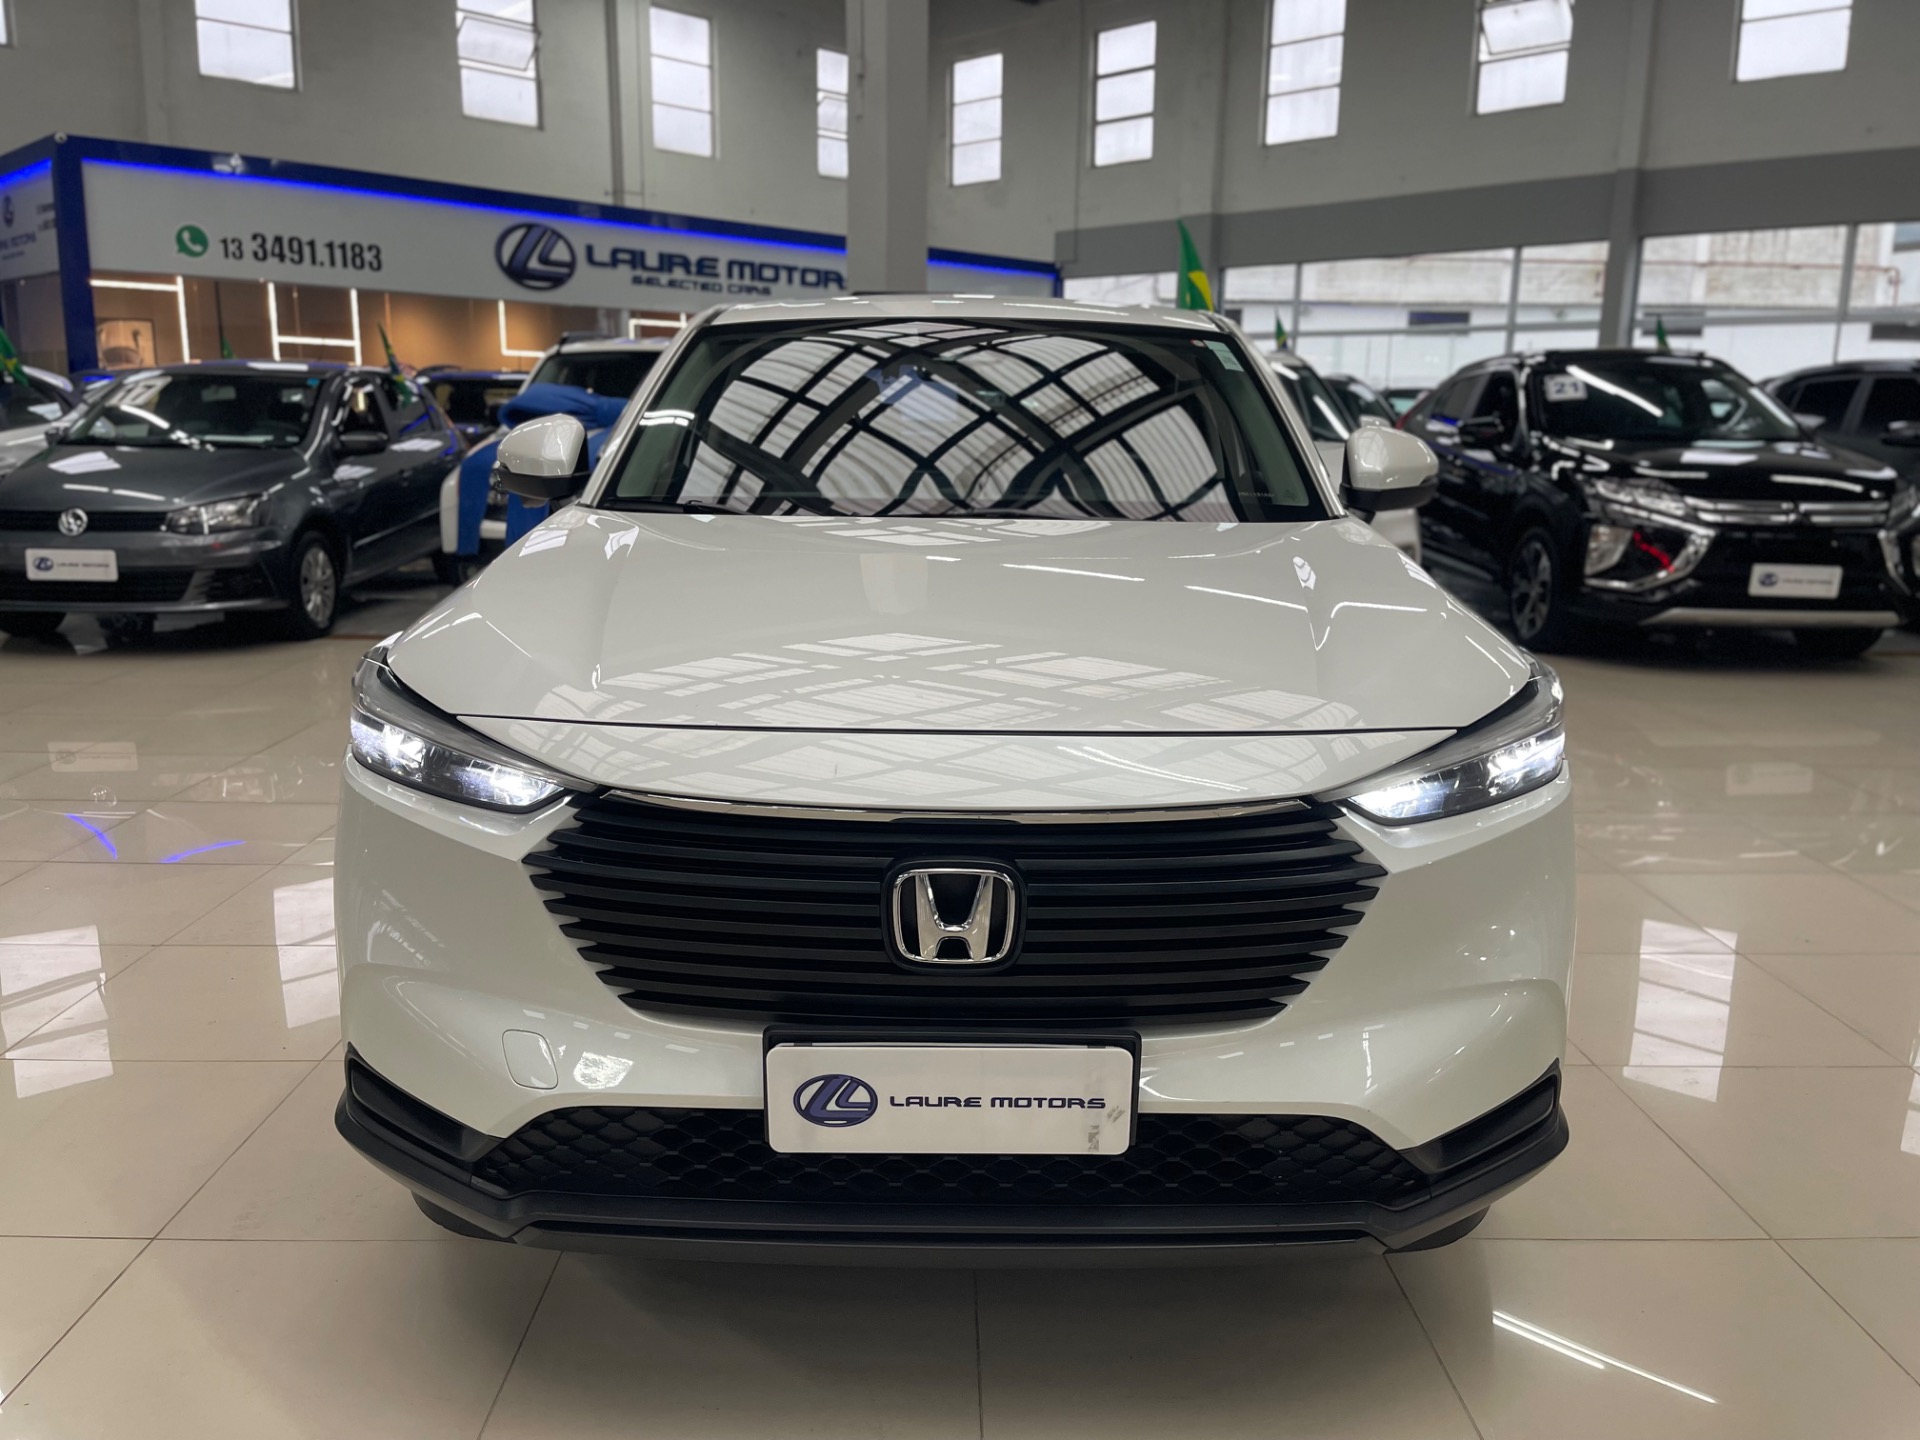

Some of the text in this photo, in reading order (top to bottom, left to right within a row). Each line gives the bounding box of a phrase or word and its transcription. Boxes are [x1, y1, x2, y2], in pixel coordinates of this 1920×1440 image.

[219, 232, 382, 272] 13 3491.1183
[585, 244, 847, 290] LAURE MOTOR
[631, 274, 772, 296] SELECTED CARS
[889, 1095, 1107, 1109] LAURE MOTORS
